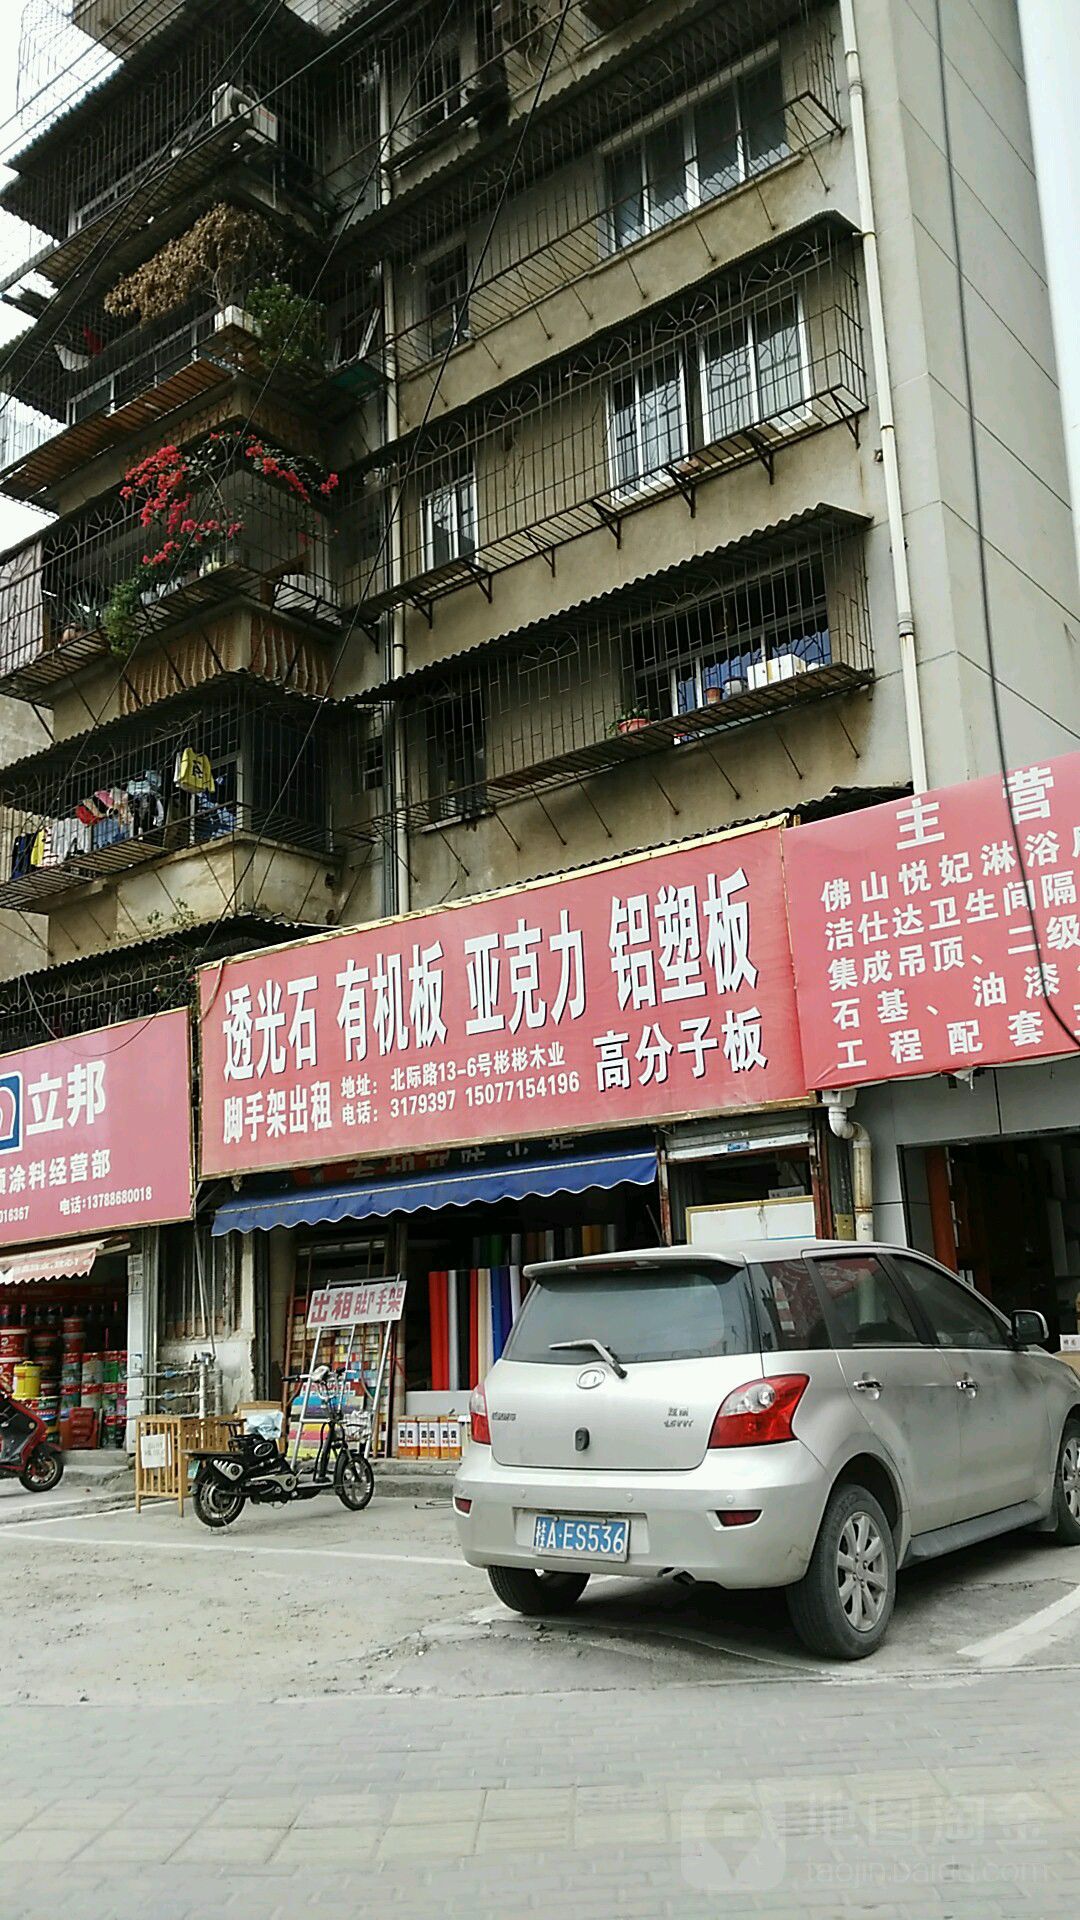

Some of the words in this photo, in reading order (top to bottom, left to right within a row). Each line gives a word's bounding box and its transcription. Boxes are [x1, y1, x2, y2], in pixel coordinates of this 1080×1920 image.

[896, 766, 1054, 850] 主营
[223, 976, 318, 1082] 透光石
[336, 940, 448, 1062] 有机板
[464, 909, 586, 1036] 亚克力
[608, 867, 759, 1010] 铝塑板
[832, 963, 1080, 1030] 石基、油漆
[593, 1007, 768, 1092] 高分子板
[26, 1059, 107, 1136] 立邦
[223, 1080, 332, 1144] 脚手架出租
[390, 1090, 456, 1118] 3179397
[465, 1071, 580, 1107] 15077154196
[311, 1287, 404, 1323] 出租脚手架
